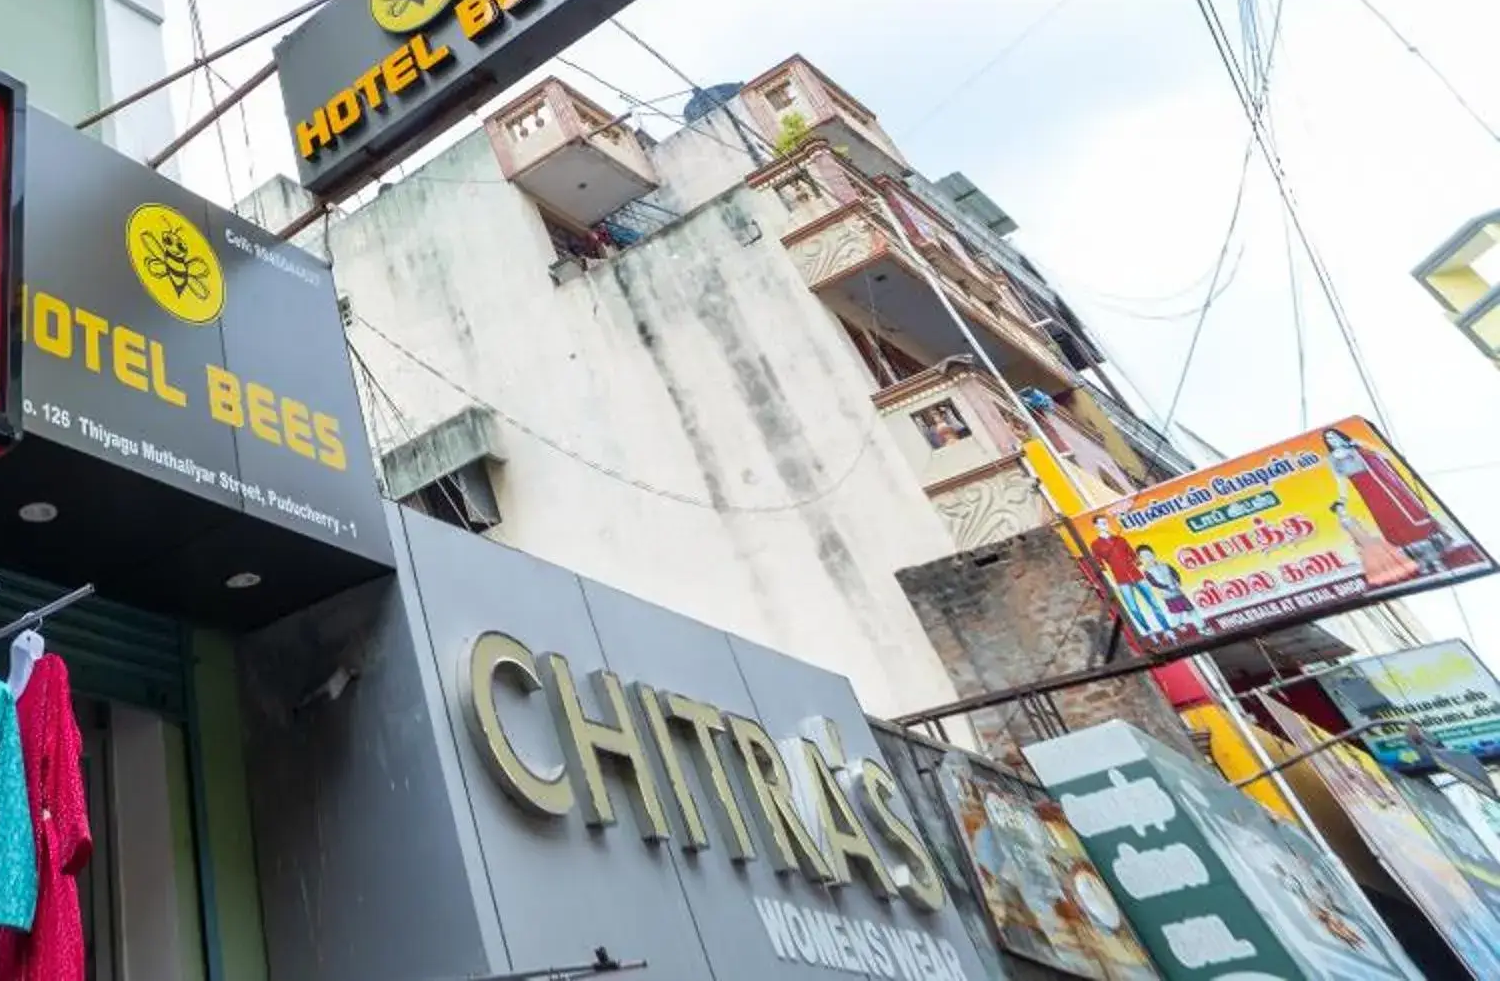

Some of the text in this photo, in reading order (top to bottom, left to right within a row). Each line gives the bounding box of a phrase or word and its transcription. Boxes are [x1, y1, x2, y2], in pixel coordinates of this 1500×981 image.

[295, 33, 451, 161] HOTEL
[22, 284, 347, 470] OTEL BEES
[23, 399, 37, 416] o.
[42, 403, 71, 428] 126
[78, 416, 139, 456] Thiyagu
[141, 440, 217, 483] Muthaliyar
[219, 471, 266, 507] Street,
[462, 630, 947, 912] CHITRA'S
[880, 923, 968, 981] WEAR
